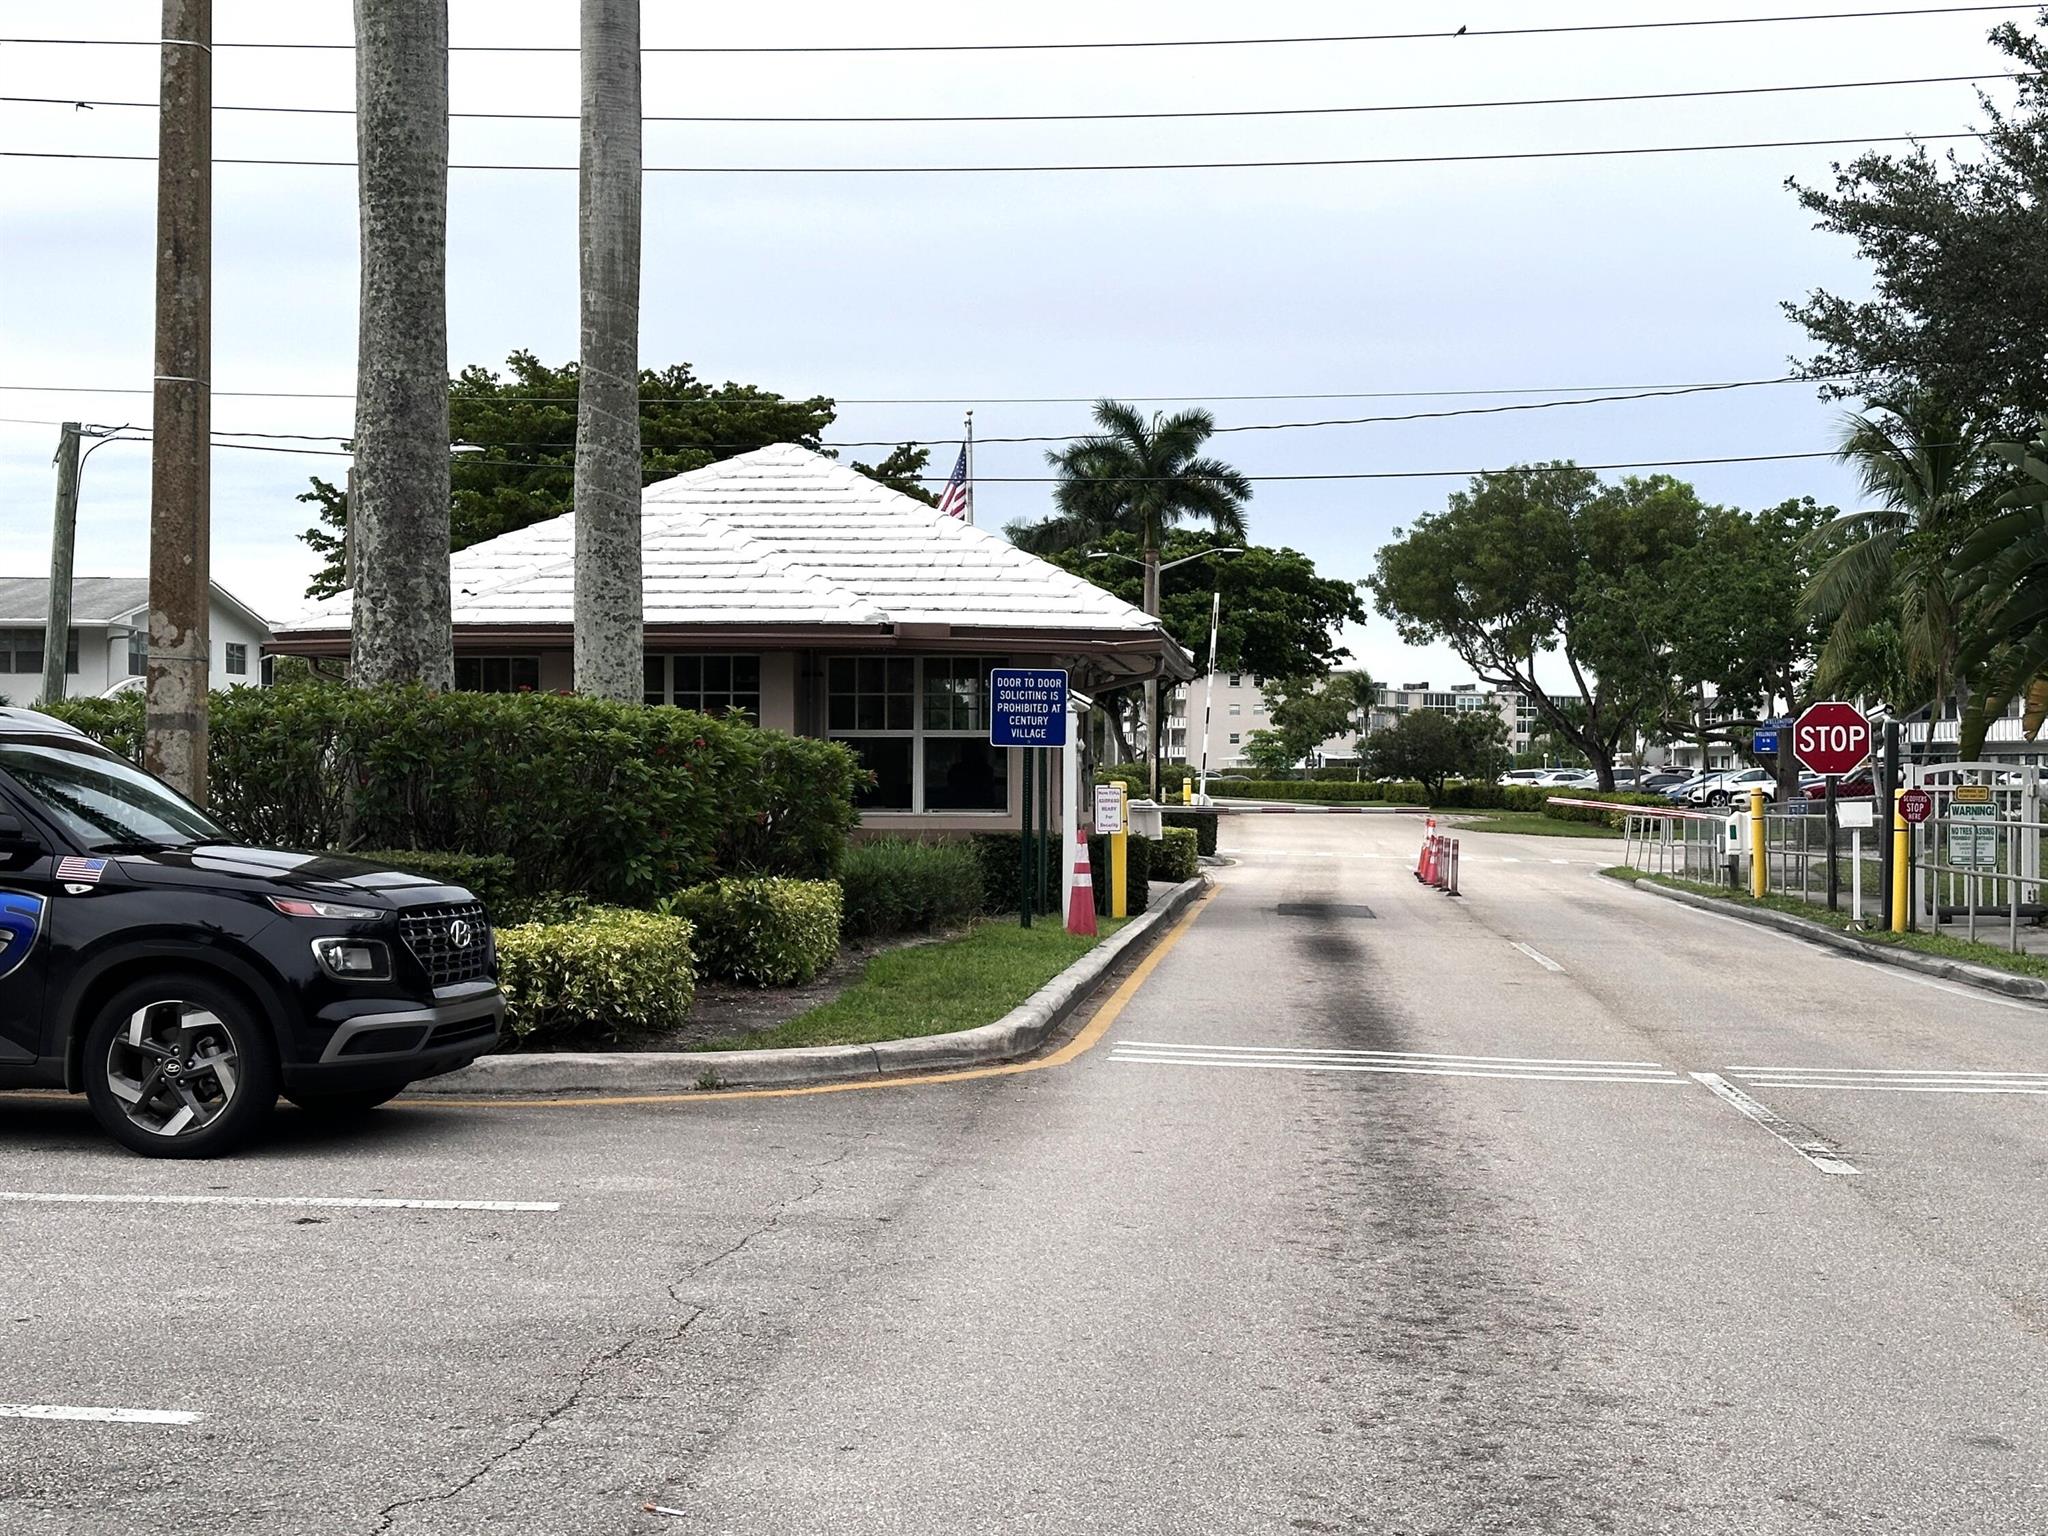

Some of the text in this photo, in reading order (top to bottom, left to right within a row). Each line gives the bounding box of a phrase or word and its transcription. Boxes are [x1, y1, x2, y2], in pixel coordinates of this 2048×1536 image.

[997, 678, 1062, 688] DOOR TO DOOR
[1000, 690, 1059, 700] SOLICITING IS
[997, 703, 1061, 713] PROHIBITED AT
[1009, 716, 1049, 725] CENTURY
[1011, 728, 1047, 738] VILLAGE
[1799, 726, 1865, 752] STOP
[1906, 803, 1924, 812] STOP
[1951, 806, 1995, 816] WARNING!
[1951, 827, 1994, 835] NO TRESASSING
